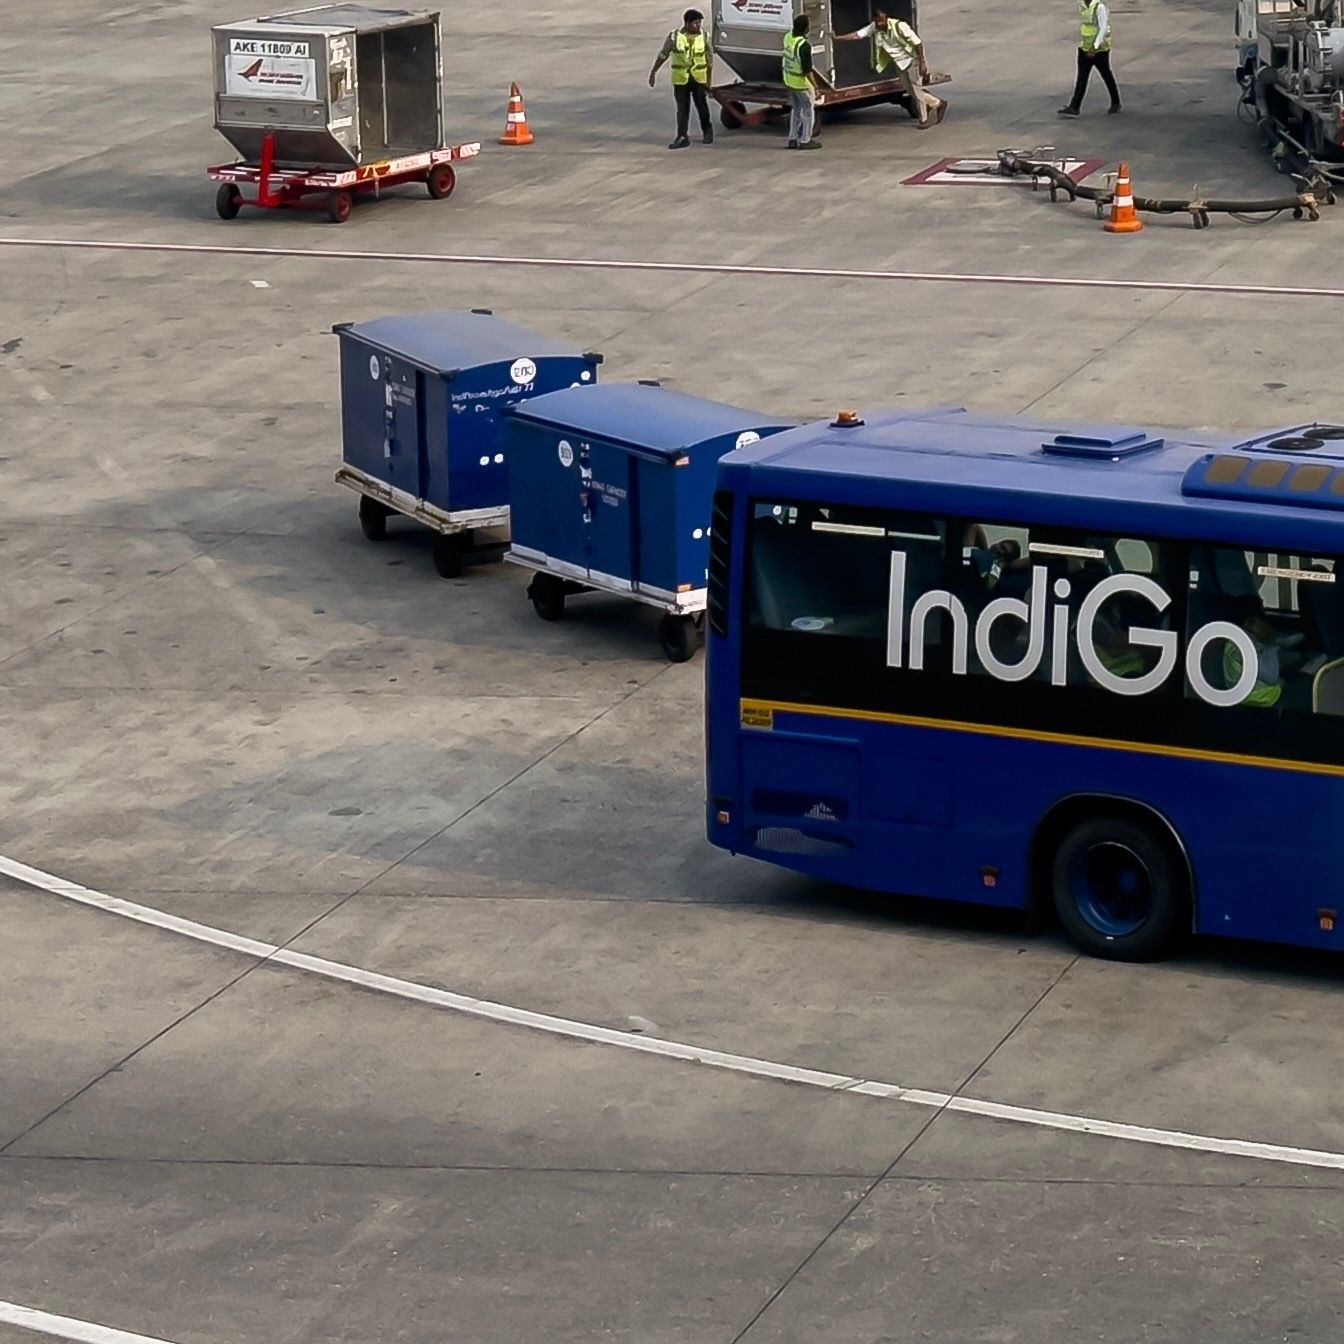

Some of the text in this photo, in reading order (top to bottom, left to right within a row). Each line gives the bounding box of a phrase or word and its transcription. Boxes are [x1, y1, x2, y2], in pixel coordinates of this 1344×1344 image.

[233, 41, 257, 53] AKE
[294, 46, 306, 56] AI
[886, 550, 1259, 707] IndiGo
